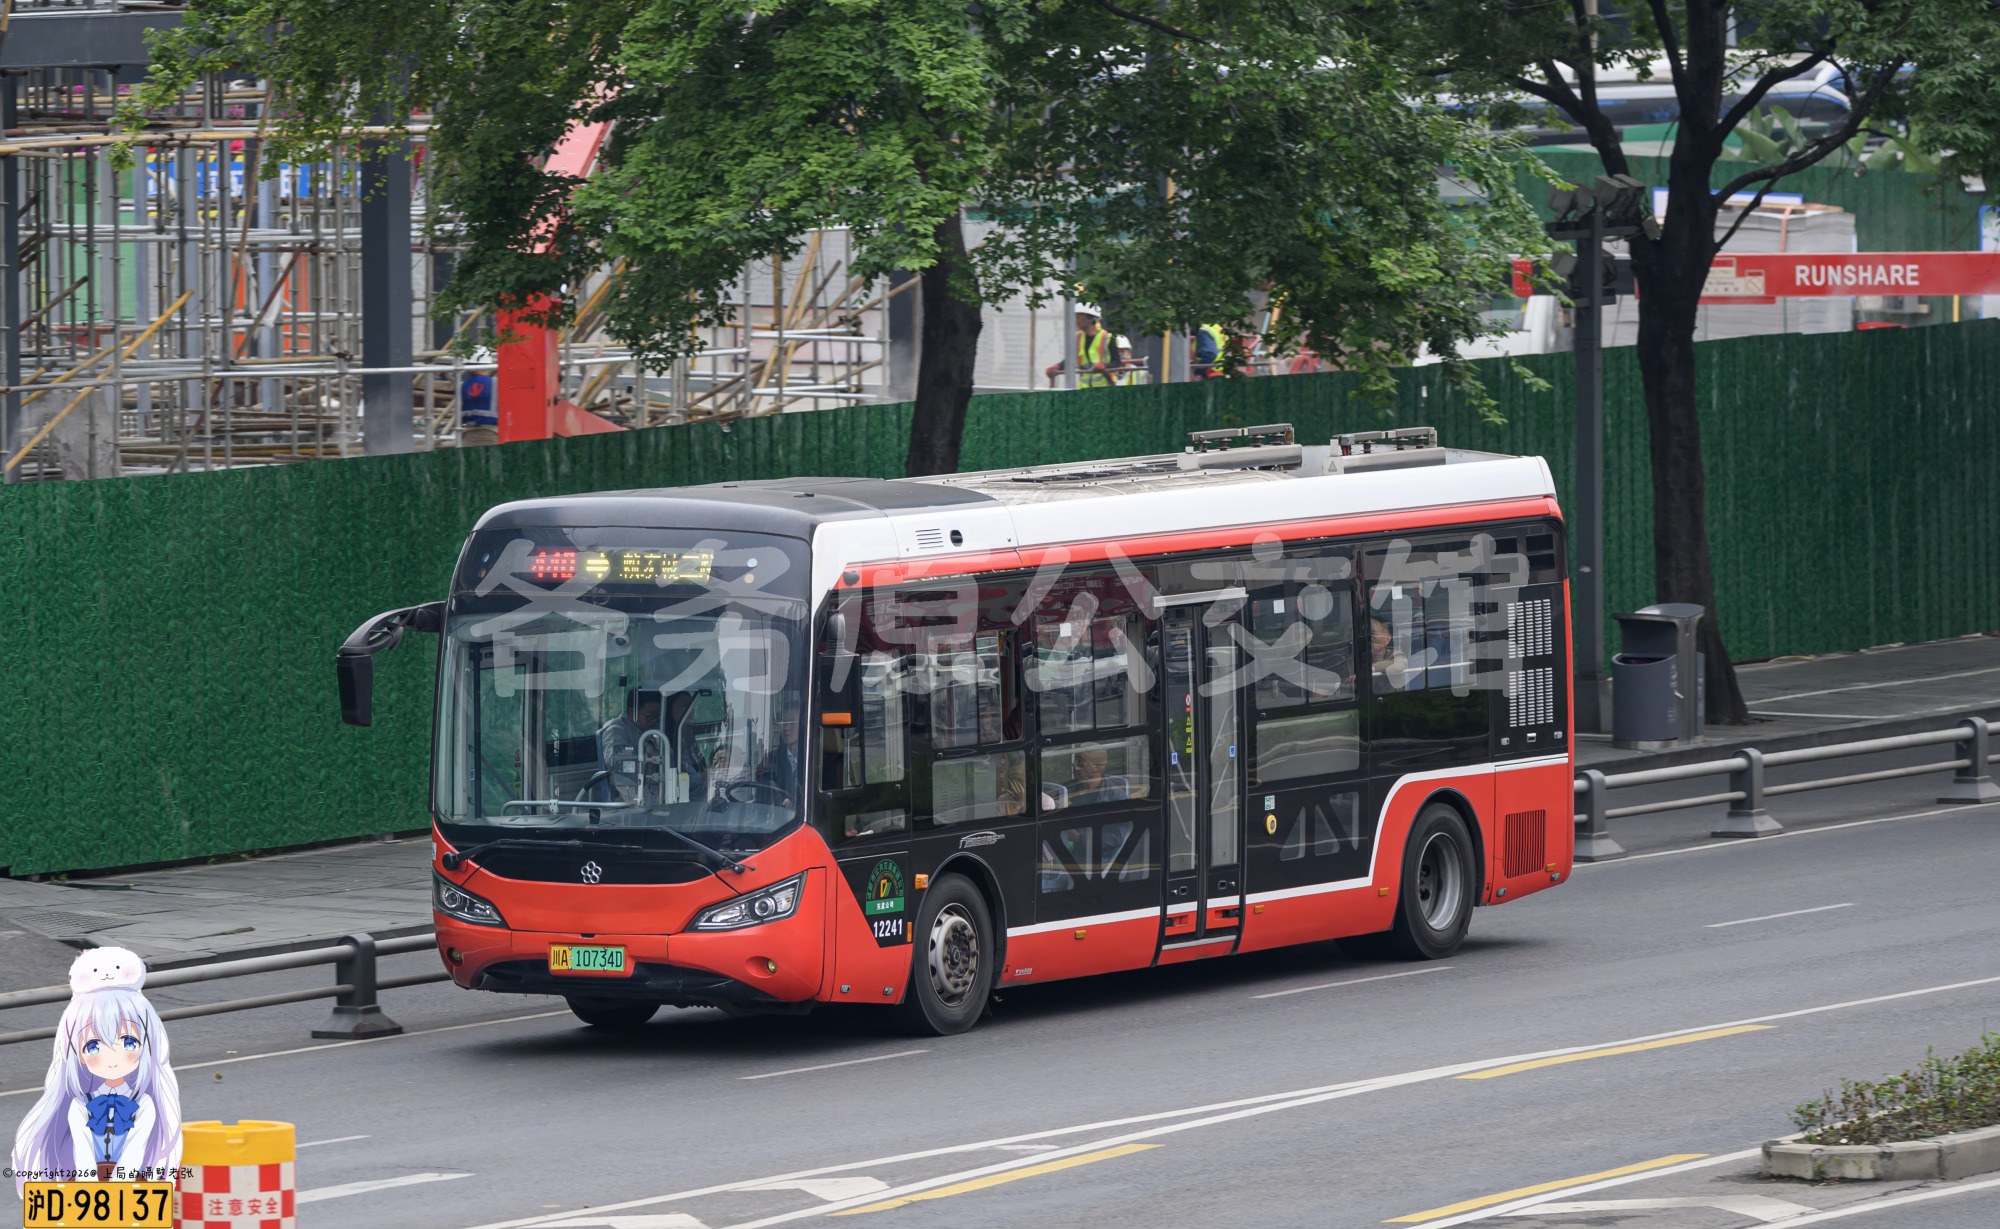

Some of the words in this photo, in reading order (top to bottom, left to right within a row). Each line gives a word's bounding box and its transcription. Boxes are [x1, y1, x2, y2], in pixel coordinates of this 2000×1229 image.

[1795, 264, 1920, 287] RUNSHARE
[873, 919, 903, 938] 12241
[208, 1197, 278, 1216] 注意安全
